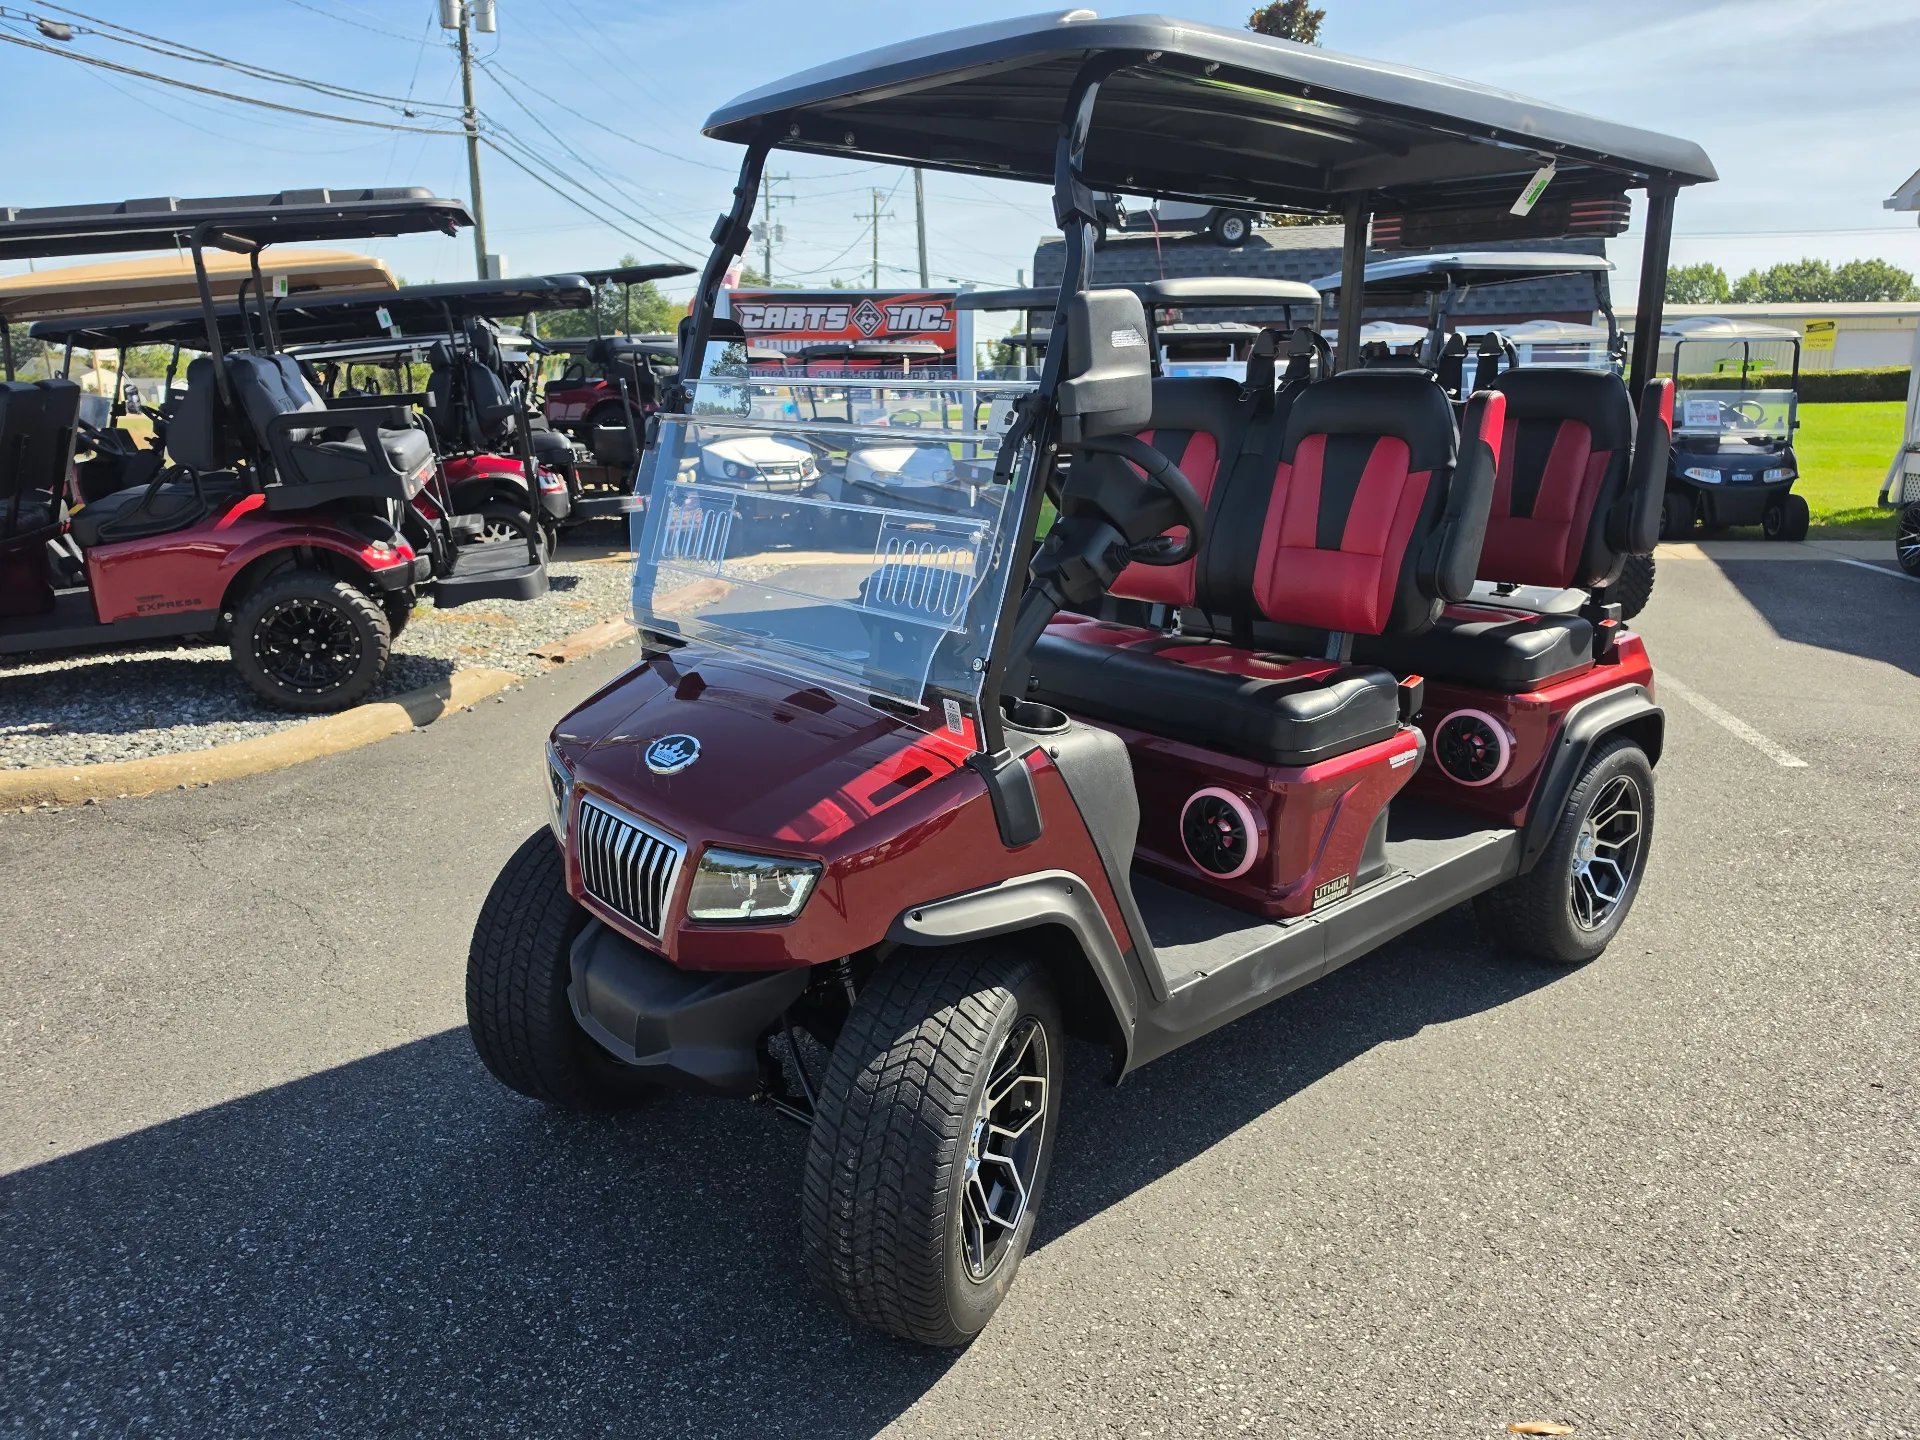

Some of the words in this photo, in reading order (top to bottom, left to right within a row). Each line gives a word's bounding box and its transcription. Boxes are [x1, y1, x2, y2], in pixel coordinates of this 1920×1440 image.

[735, 303, 852, 332] CARTS
[136, 598, 203, 612] EXPRESS
[1314, 875, 1350, 900] LITHIUM
